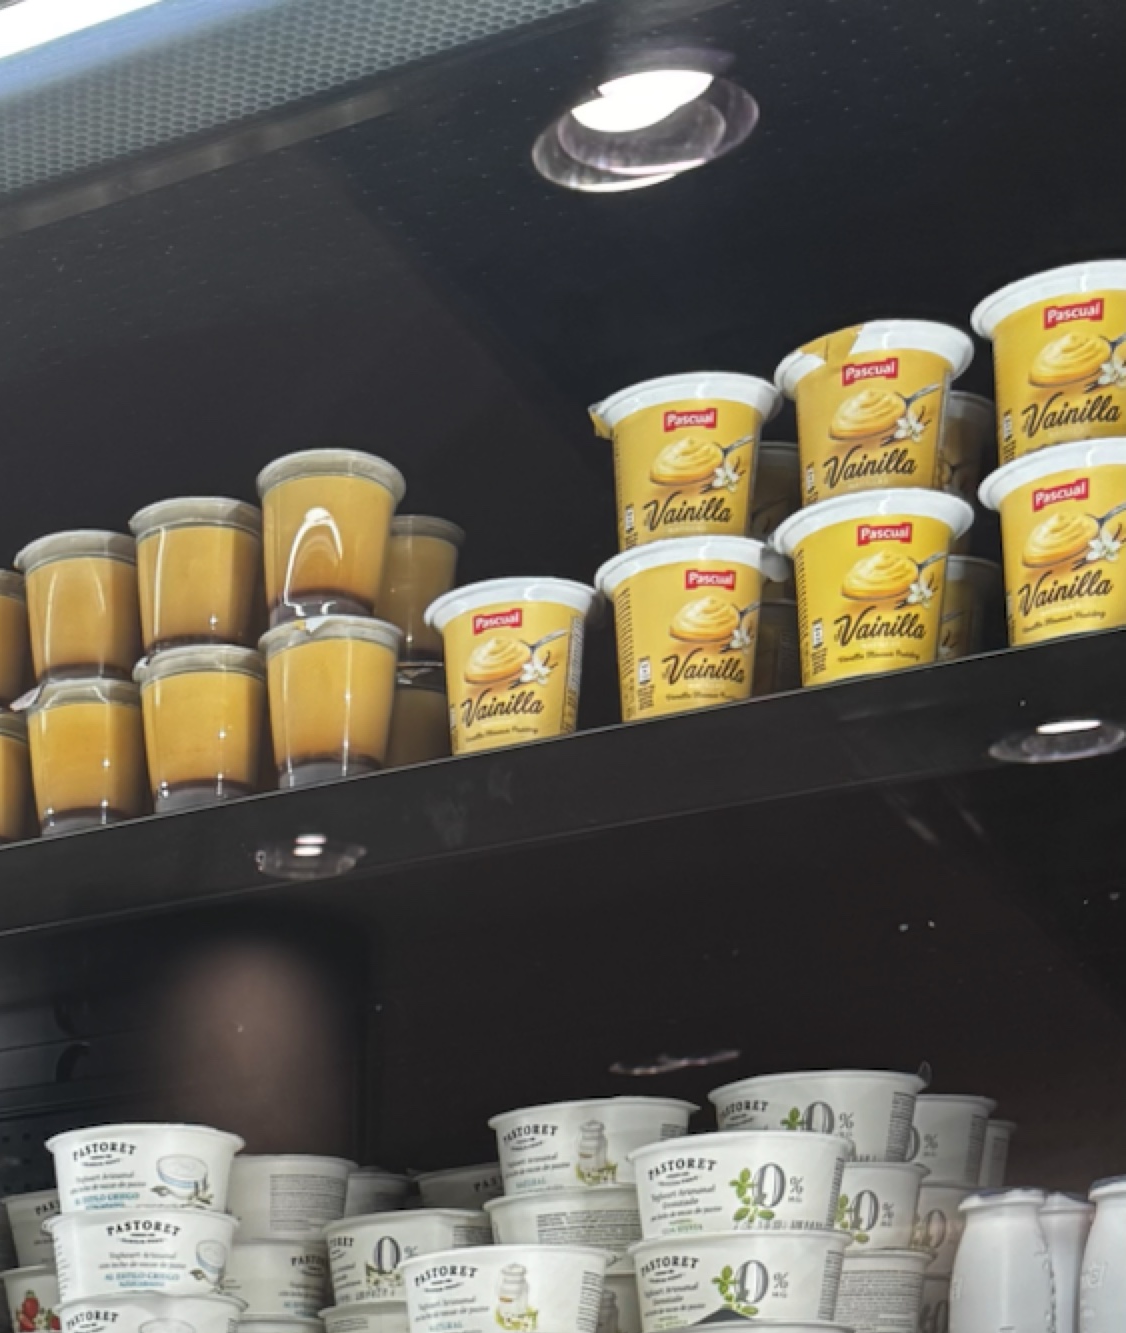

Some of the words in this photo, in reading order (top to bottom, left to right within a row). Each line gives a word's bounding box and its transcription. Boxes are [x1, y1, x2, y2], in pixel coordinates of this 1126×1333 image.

[1048, 304, 1101, 324] Pascual
[845, 363, 895, 383] Pascual
[667, 412, 715, 428] Pascual
[1021, 392, 1121, 436] Vainilla
[823, 445, 916, 487] Vainilla
[1036, 483, 1086, 506] Pascual
[643, 492, 732, 531] Vainilla
[861, 526, 909, 543] Pascual
[688, 573, 734, 590] Pascual
[1018, 570, 1113, 616] Vainilla
[475, 613, 520, 631] Pascual
[834, 607, 926, 644] Vainilla
[662, 649, 745, 683] Vainilla
[461, 690, 545, 727] Vainilla
[73, 1142, 136, 1162] PASTORET
[648, 1157, 718, 1181] PASTORET
[106, 1219, 181, 1237] PASTORET
[641, 1255, 700, 1277] PASTORET
